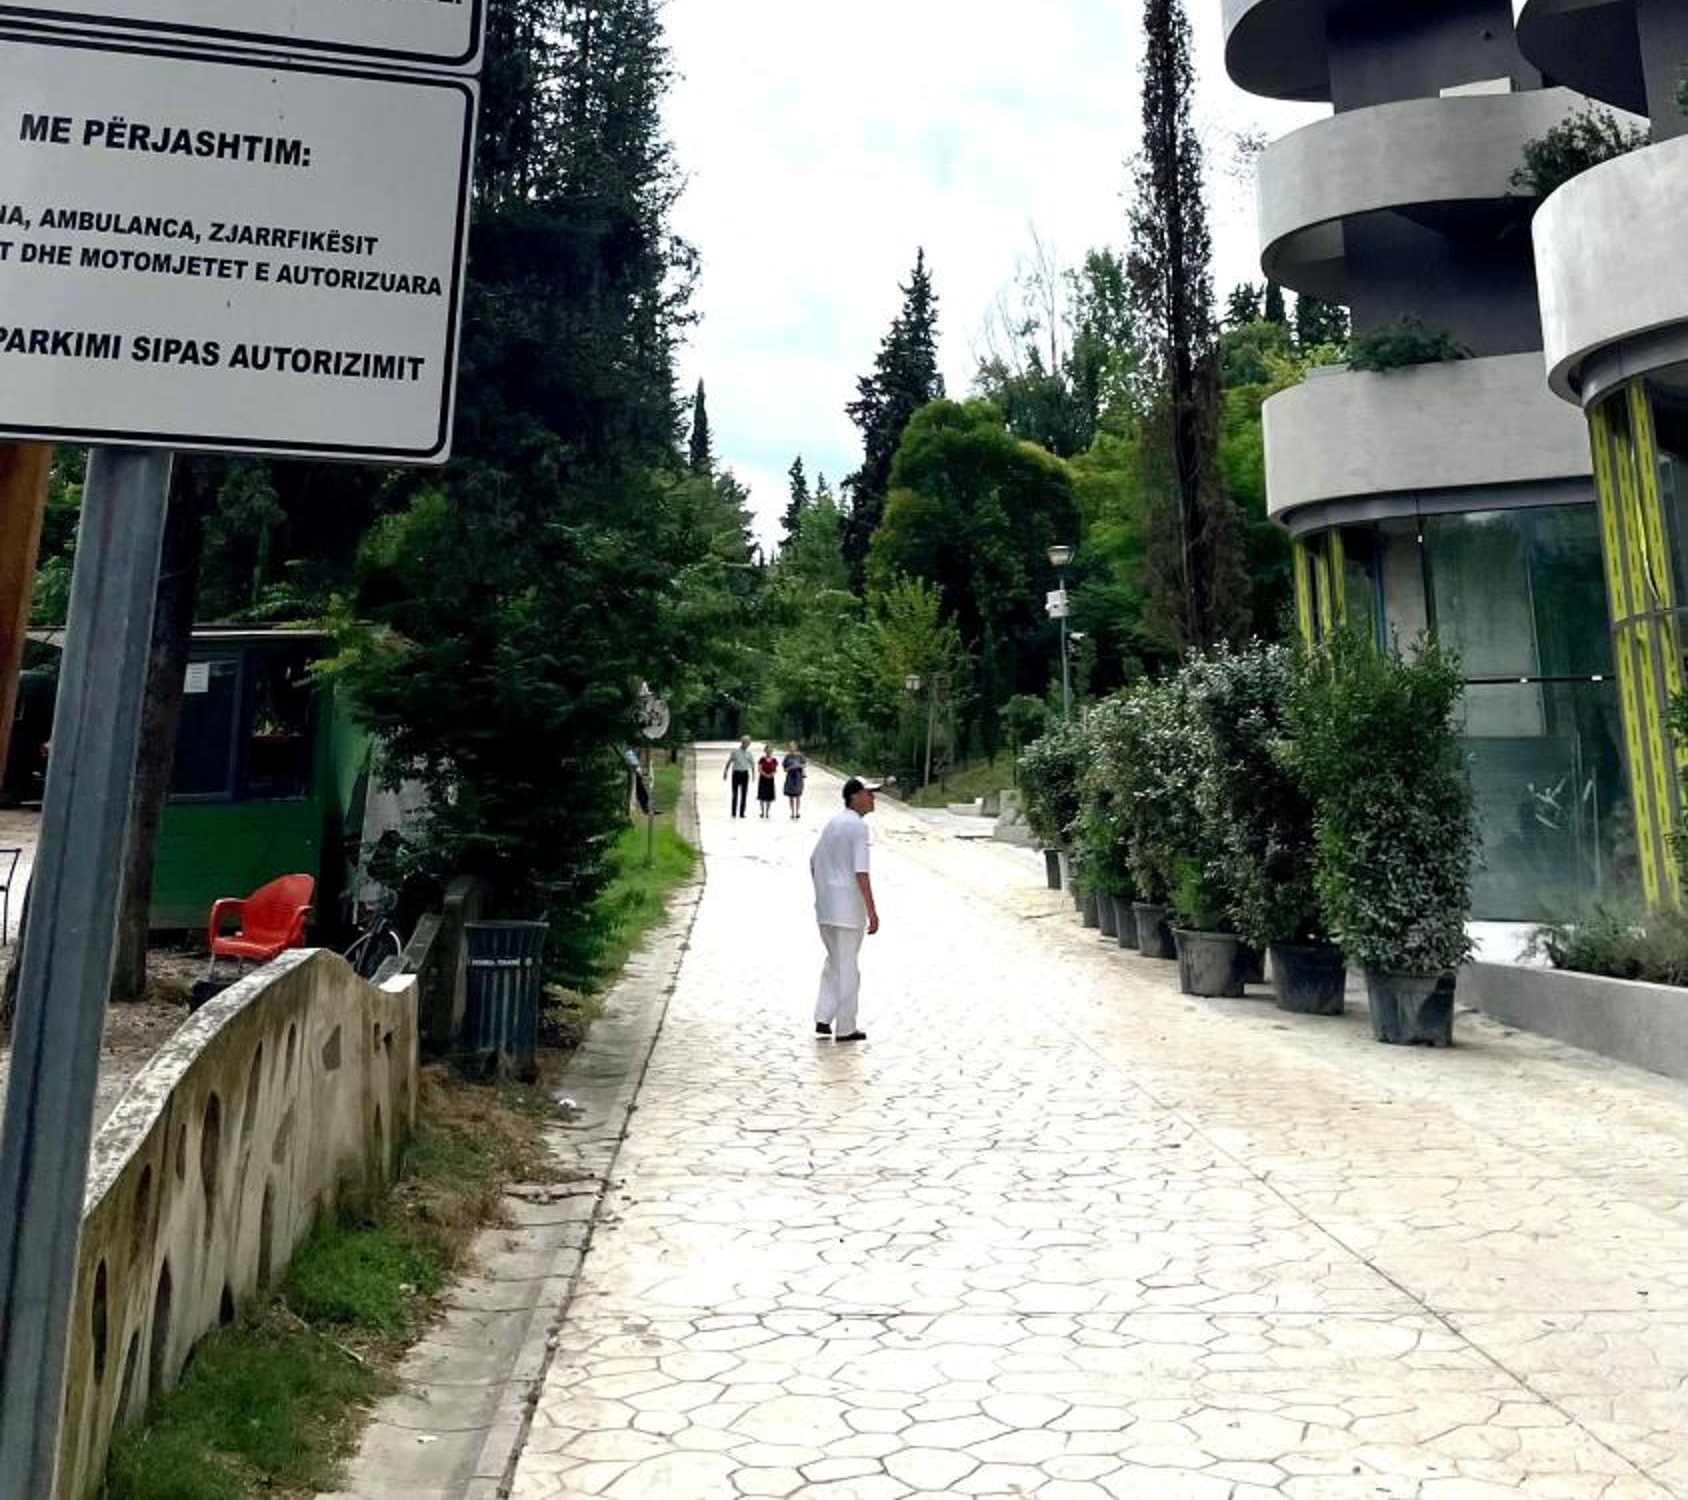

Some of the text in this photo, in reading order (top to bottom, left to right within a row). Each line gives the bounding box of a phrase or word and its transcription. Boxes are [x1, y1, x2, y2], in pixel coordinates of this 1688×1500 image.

[20, 114, 311, 166] ME PËRJASHTIM:
[40, 209, 200, 244] AMBULANCA,
[209, 223, 379, 256] ZJARRFIKËSIT
[21, 244, 72, 265] DHE
[80, 248, 249, 280] MOTOMJETET
[256, 262, 269, 281] E
[276, 265, 442, 296] AUTORIZUARA
[132, 337, 220, 366] SIPAS
[229, 344, 425, 381] AUTORIZIMIT
